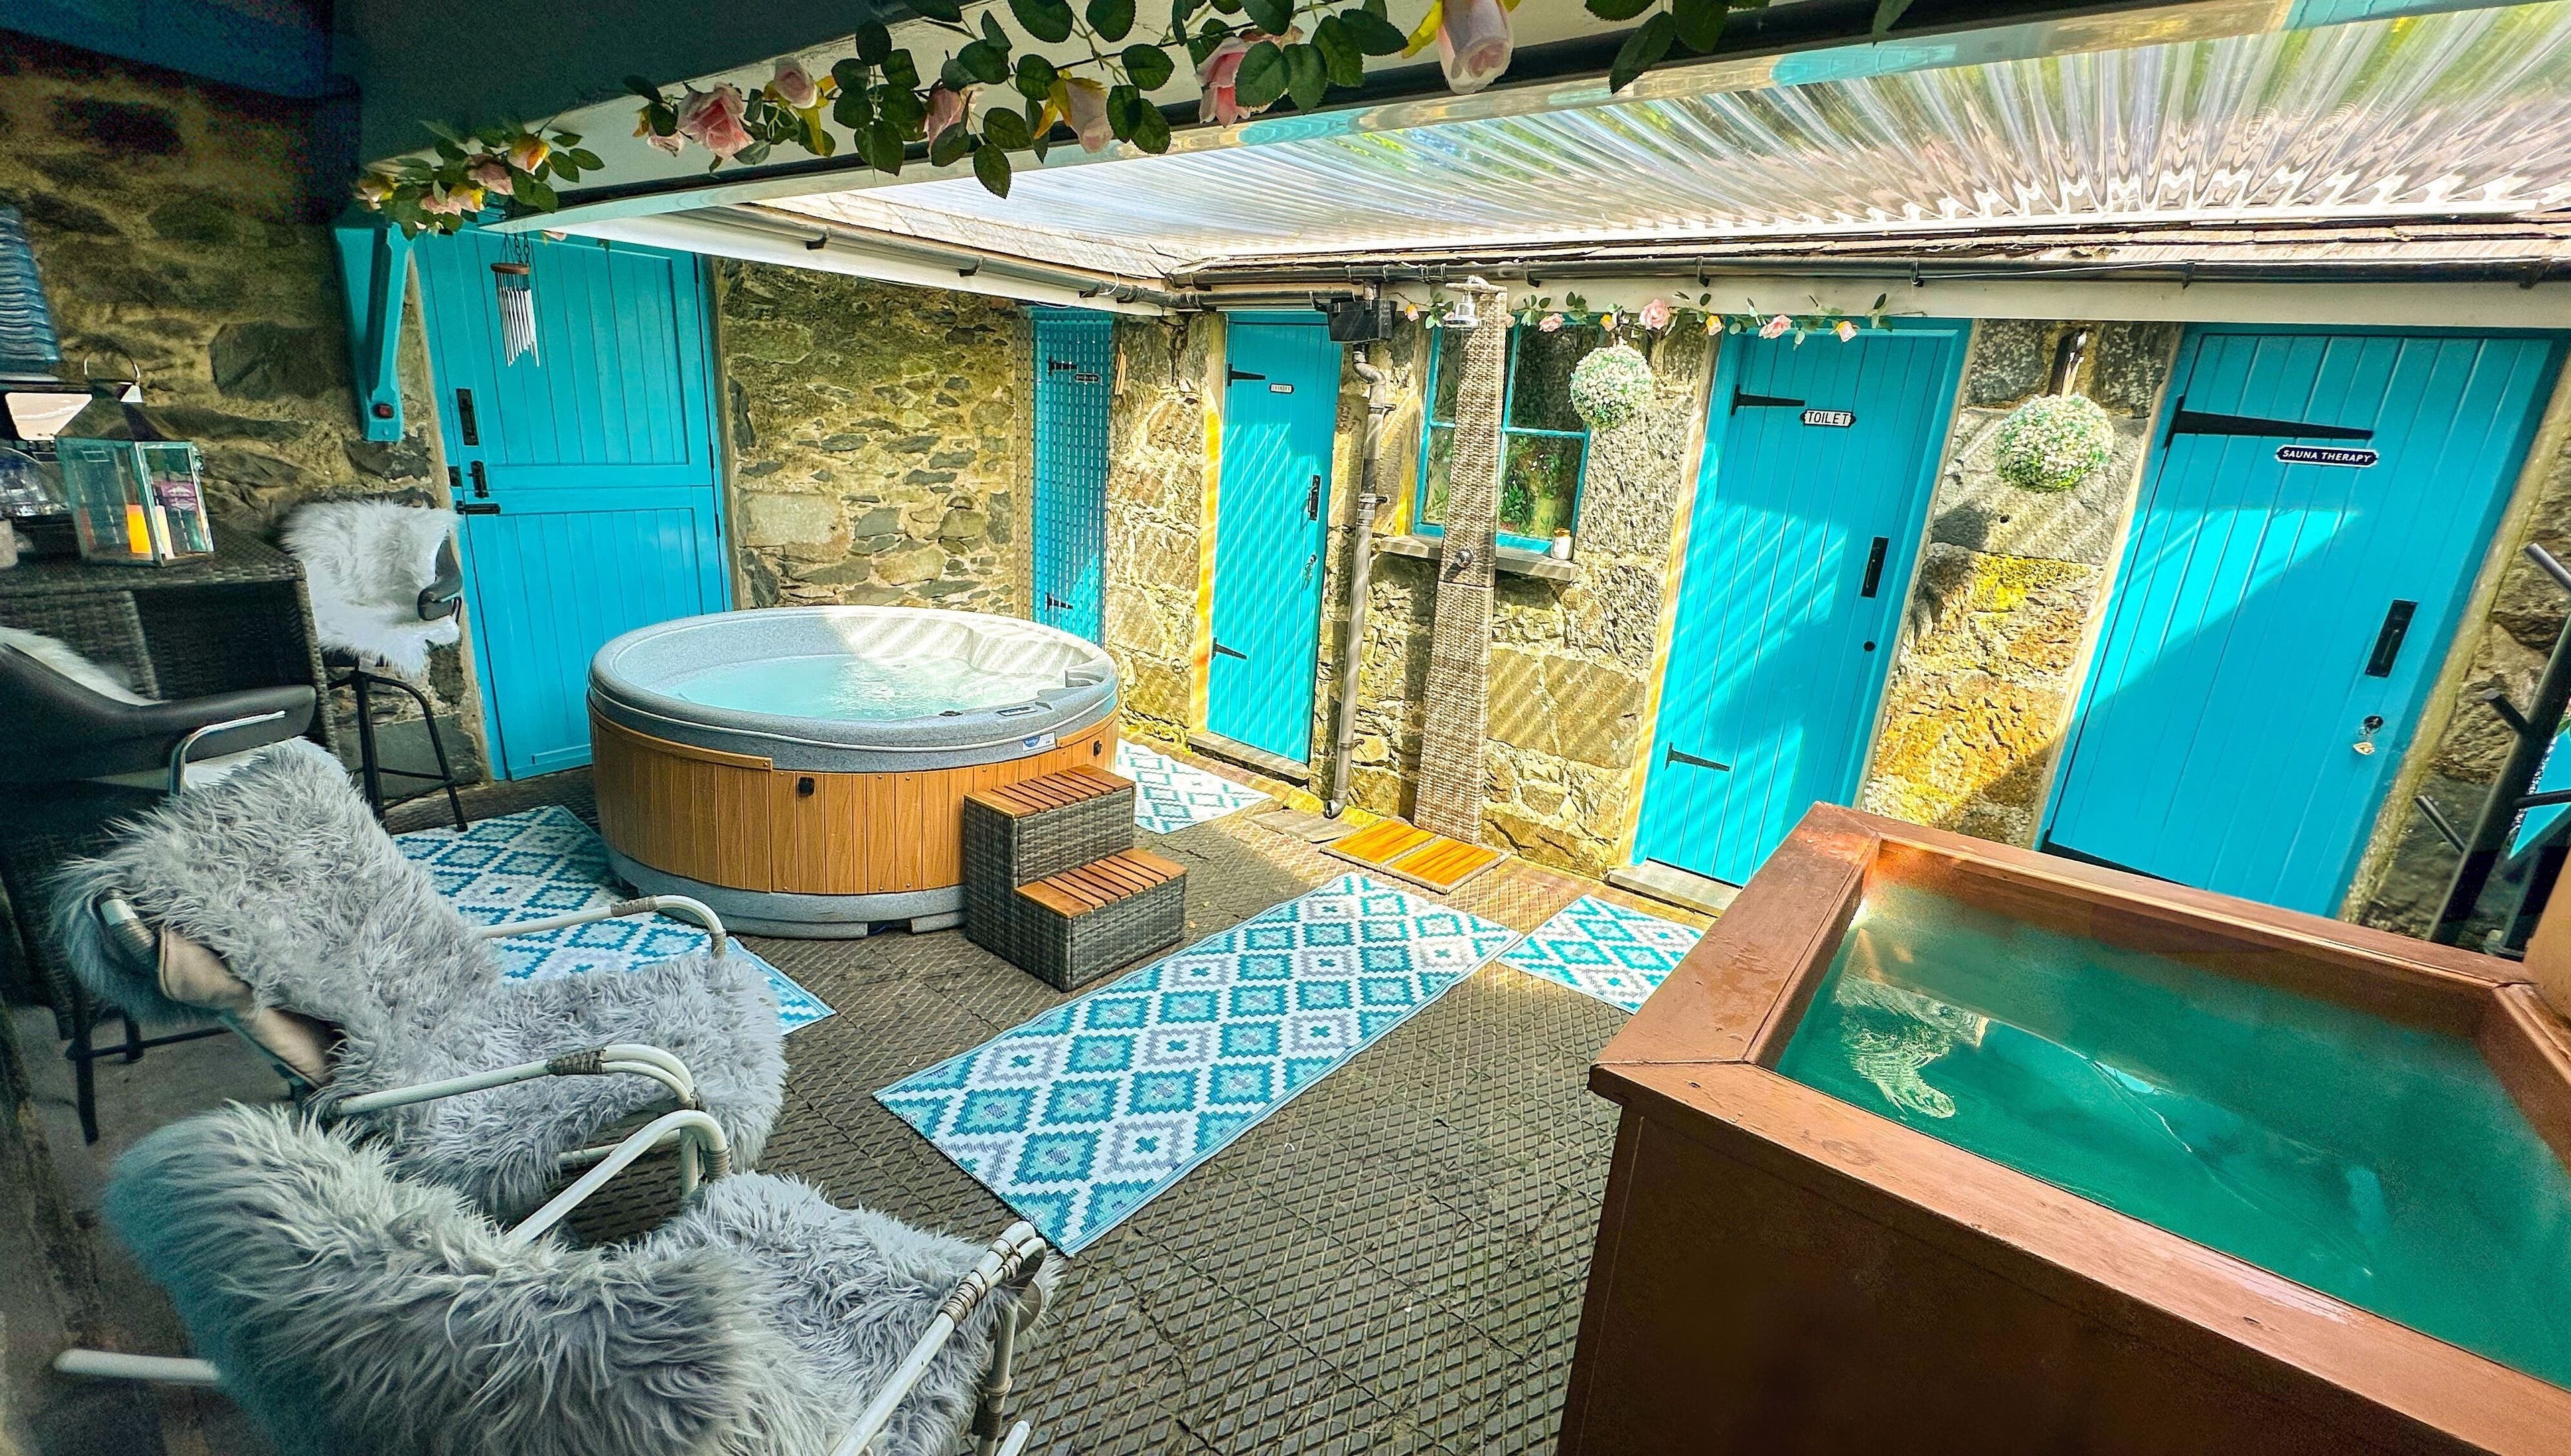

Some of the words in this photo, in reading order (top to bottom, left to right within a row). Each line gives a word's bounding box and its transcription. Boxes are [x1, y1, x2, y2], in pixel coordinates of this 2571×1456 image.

[1808, 412, 1849, 424] TOILET
[2282, 450, 2317, 459] SAUNA
[2321, 452, 2371, 463] THERAPY
